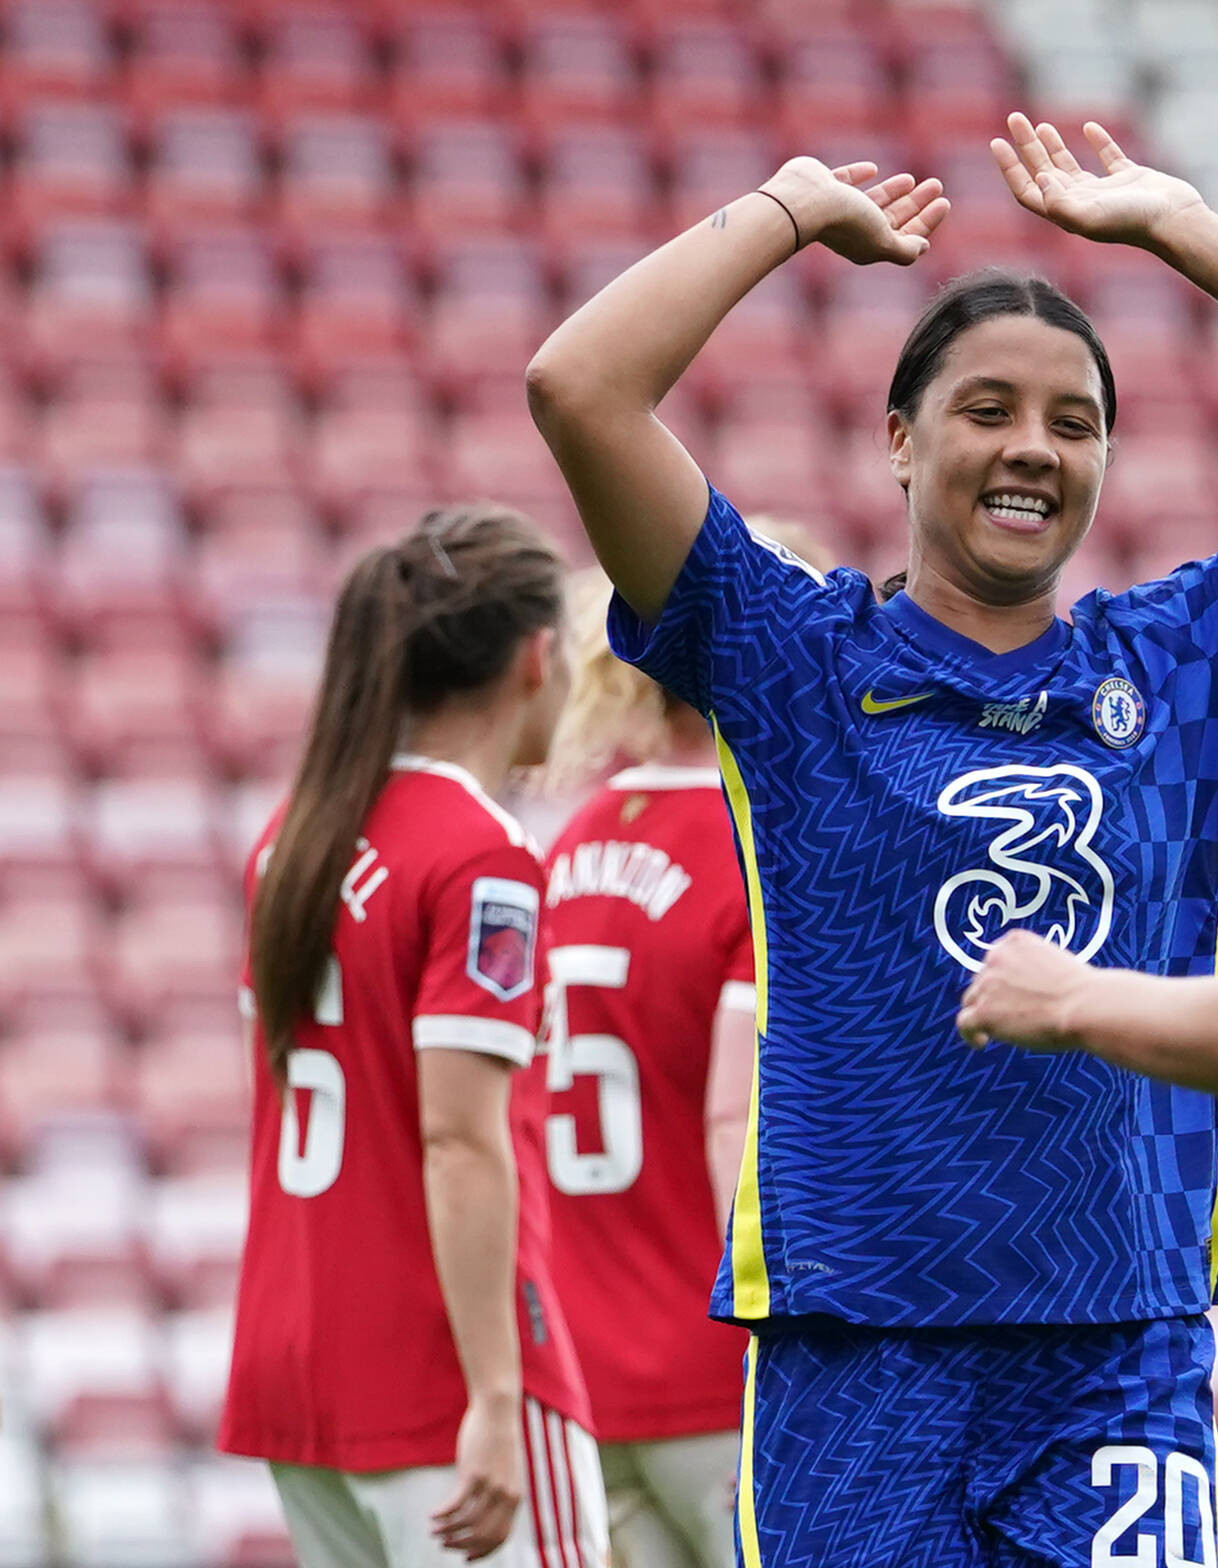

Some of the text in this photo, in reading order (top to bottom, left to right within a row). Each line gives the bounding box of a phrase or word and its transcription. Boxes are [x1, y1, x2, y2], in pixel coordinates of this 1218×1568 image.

[1100, 681, 1135, 697] CHELSEA
[1033, 690, 1049, 714] A
[1091, 1445, 1218, 1568] 20
